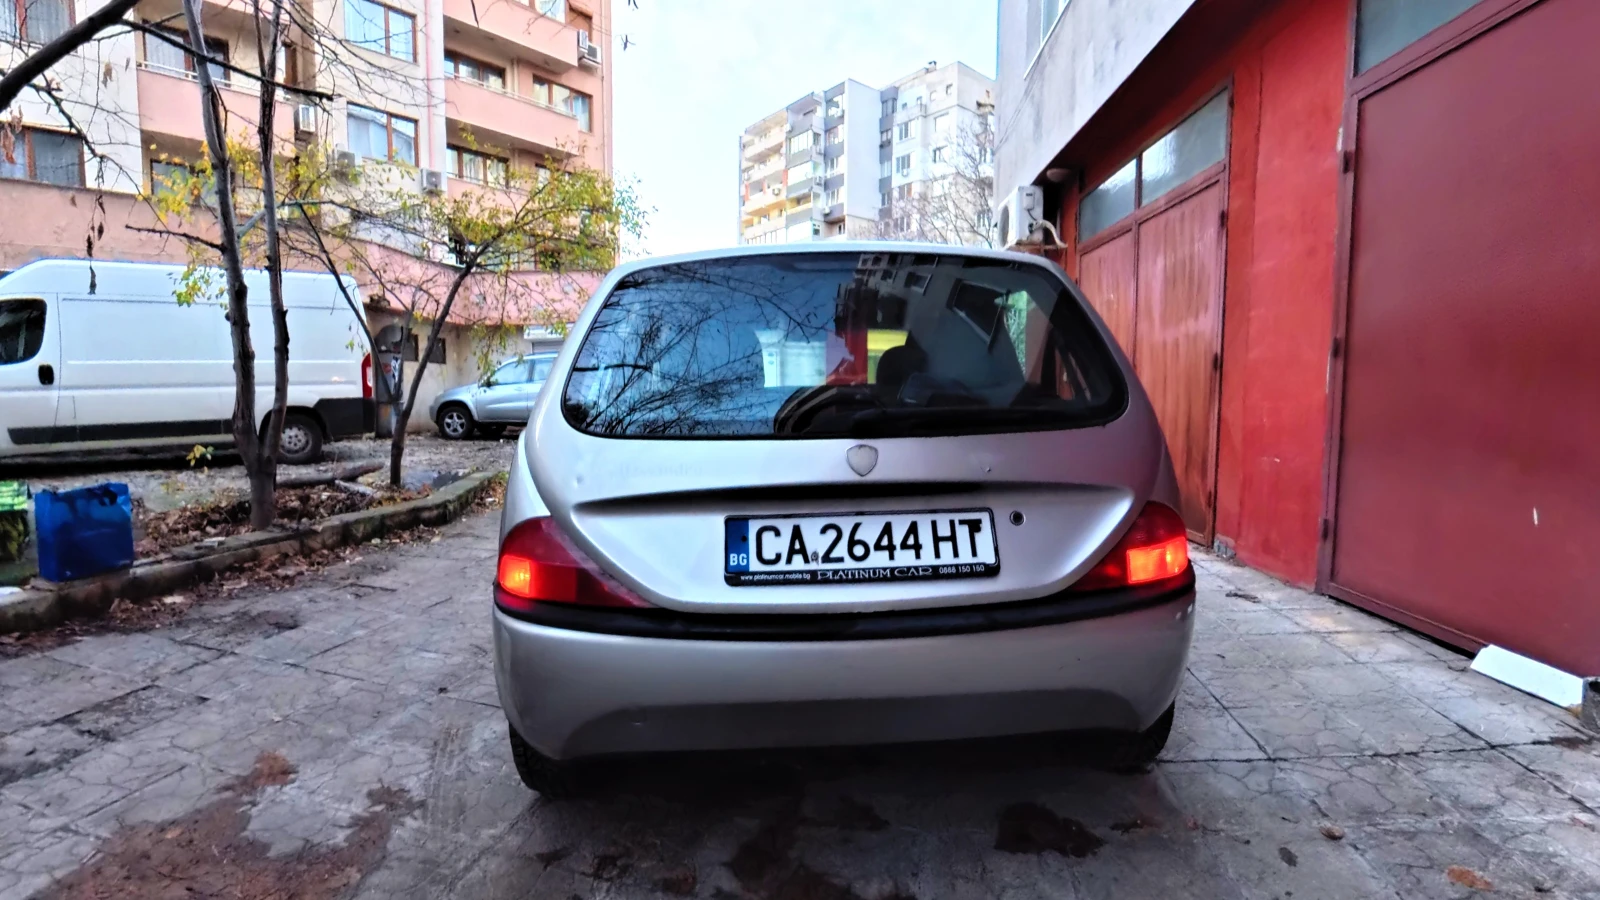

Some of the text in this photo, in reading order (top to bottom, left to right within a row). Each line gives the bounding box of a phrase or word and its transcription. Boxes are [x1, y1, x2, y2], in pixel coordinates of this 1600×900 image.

[819, 520, 923, 563] 2644
[930, 518, 983, 560] HT
[729, 553, 748, 566] BG
[817, 566, 933, 581] PLATINUM CAR
[959, 565, 971, 573] 150
